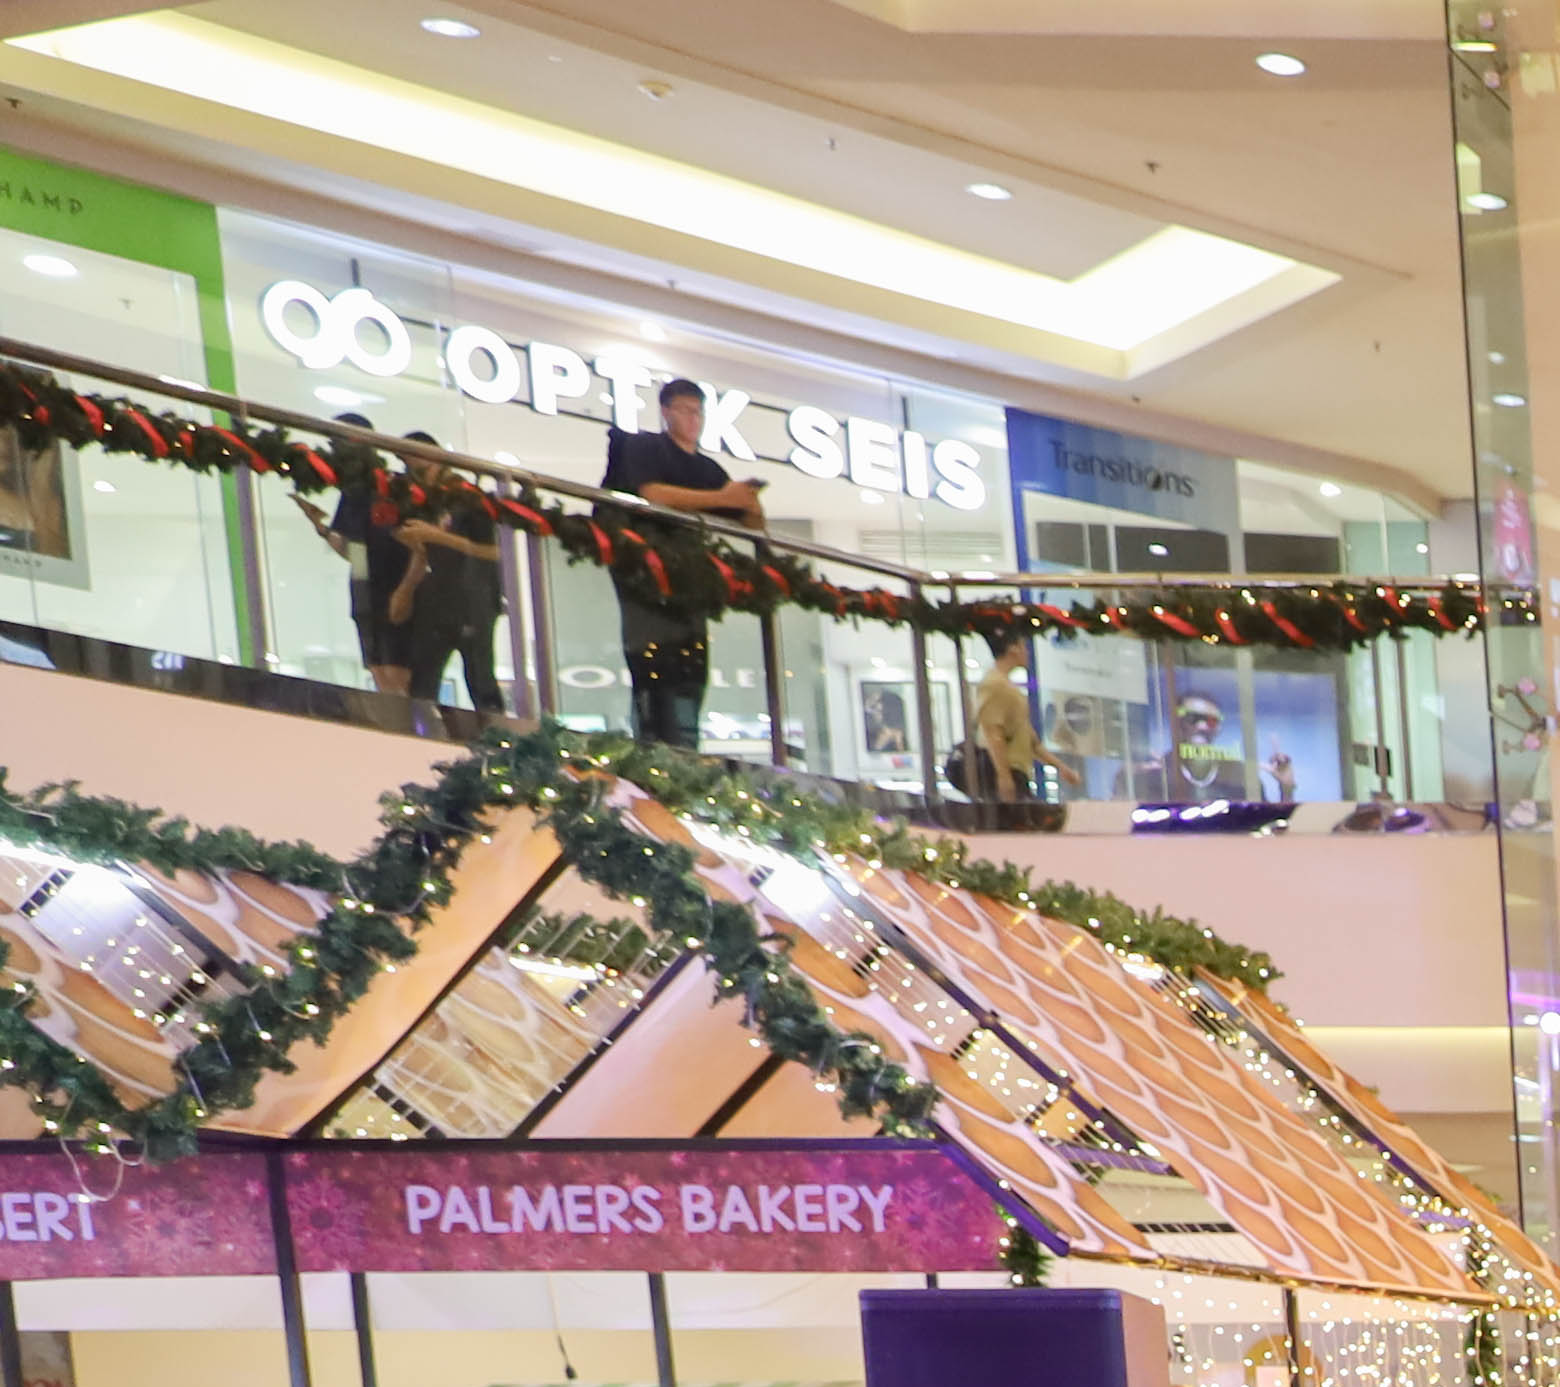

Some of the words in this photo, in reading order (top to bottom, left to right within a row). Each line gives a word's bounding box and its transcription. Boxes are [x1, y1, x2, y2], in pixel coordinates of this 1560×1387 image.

[445, 323, 759, 462] OPTK
[787, 405, 990, 512] SEIS
[1047, 438, 1196, 501] Transitions
[405, 1184, 664, 1234] PALMERS
[680, 1184, 894, 1234] BAKERY
